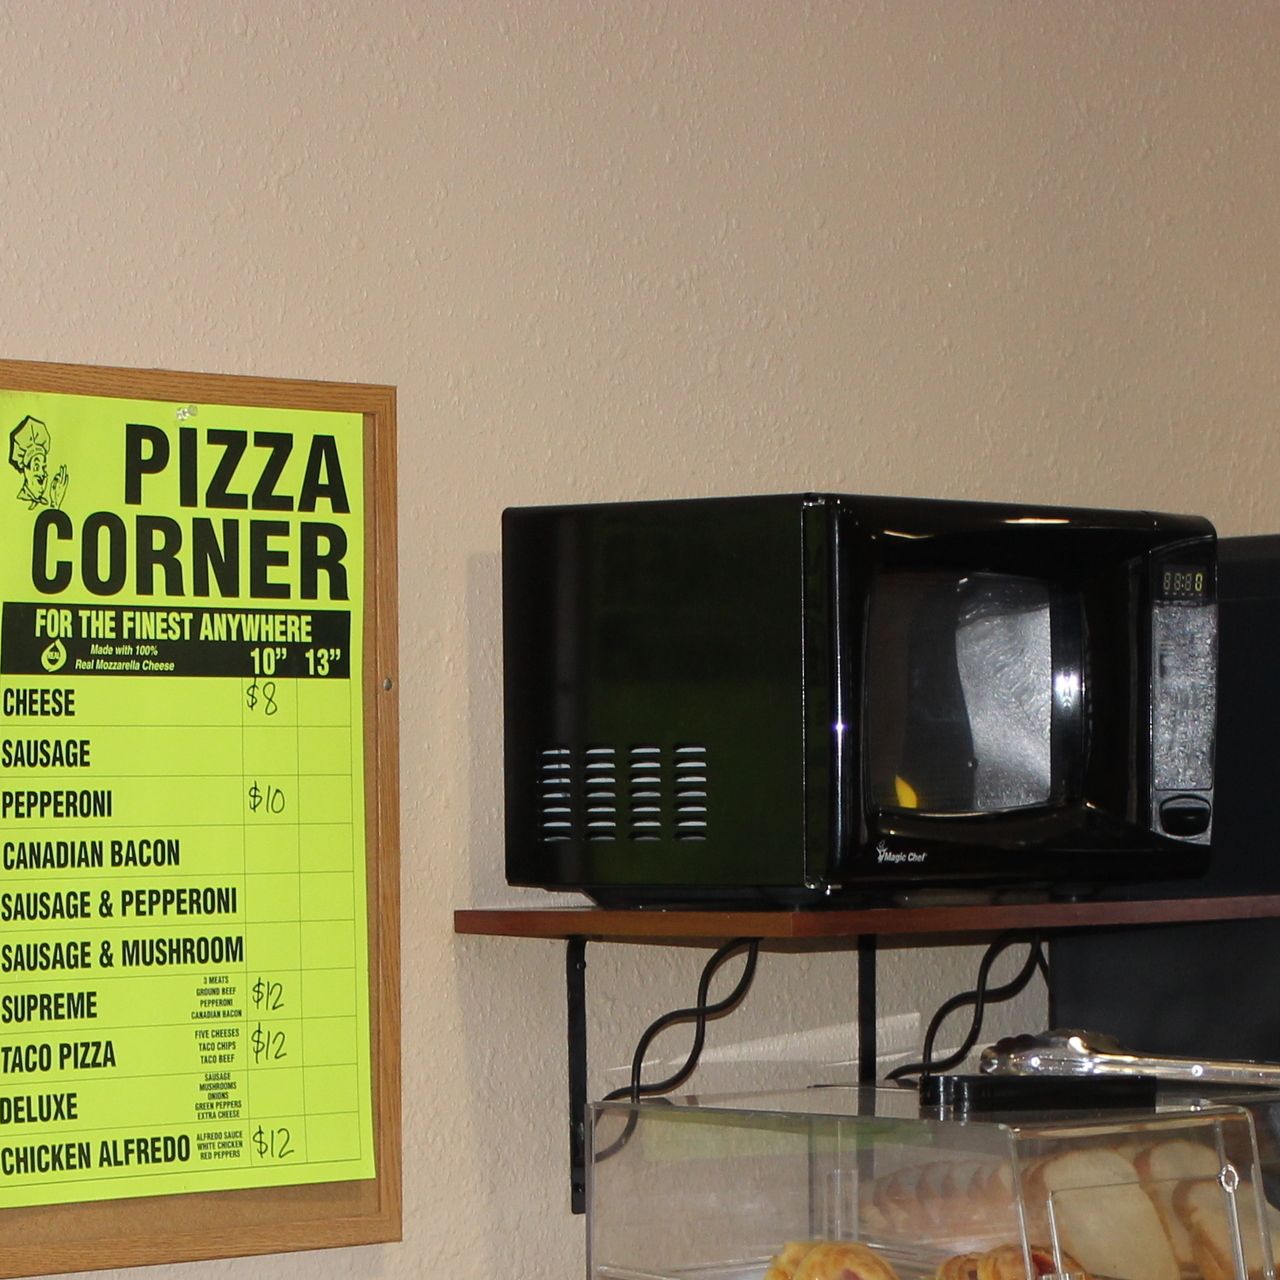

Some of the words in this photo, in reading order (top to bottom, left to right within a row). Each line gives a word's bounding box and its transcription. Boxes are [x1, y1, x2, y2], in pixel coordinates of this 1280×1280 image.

[124, 424, 351, 514] PIZZA
[32, 509, 350, 601] CORNER
[35, 609, 73, 639] FOR
[79, 611, 116, 640] THE
[122, 611, 193, 642] FINEST
[200, 613, 313, 644] ANYWHERE
[91, 644, 114, 655] Made
[115, 644, 133, 656] with
[135, 645, 159, 657] 100%
[75, 658, 94, 670] Real
[95, 659, 140, 671] Mozzarella
[141, 660, 175, 672] Cheese
[3, 688, 75, 717] CHEESE
[246, 677, 279, 716] $8
[1, 739, 90, 768] SAUSAGE
[2, 790, 112, 819] PEPPERONI
[248, 781, 286, 814] $10
[3, 841, 104, 870] CANADIAN
[111, 839, 180, 867] BACON
[883, 851, 907, 864] Magic
[907, 851, 926, 863] Chef
[1, 890, 91, 921] SAUSAGE
[98, 891, 113, 917] &
[121, 887, 238, 917] PEPPERONI
[1, 941, 91, 972] SAUSAGE
[99, 940, 114, 967] &
[121, 936, 244, 968] MUSHROOM
[208, 975, 229, 985] MEATS
[196, 987, 220, 996] GROUND
[221, 986, 237, 996] BEEF
[252, 976, 285, 1011] $12
[1, 991, 98, 1024] SUPREME
[200, 998, 233, 1008] PEPPERONI
[191, 1010, 221, 1020] CANADIAN
[222, 1009, 242, 1019] BACON
[195, 1029, 209, 1039] FIVE
[211, 1028, 240, 1038] CHEESES
[251, 1021, 288, 1064] $12
[1, 1043, 52, 1074] TACO
[59, 1040, 116, 1071] PIZZA
[199, 1042, 215, 1052] TACO
[217, 1041, 236, 1051] CHIPS
[200, 1055, 217, 1064] TACO
[218, 1054, 235, 1064] BEEF
[199, 1081, 237, 1091] MUSHROOMS
[204, 1072, 231, 1082] SAUSAGE
[195, 1101, 214, 1111] GREEN
[215, 1100, 242, 1110] PEPPERS
[207, 1091, 229, 1101] ONIONS
[0, 1092, 78, 1125] DELUXE
[197, 1111, 216, 1120] EXTRA
[218, 1110, 240, 1119] CHEESE
[196, 1132, 222, 1141] ALFREDO
[224, 1130, 243, 1139] SAUCE
[197, 1142, 216, 1151] WHITE
[217, 1140, 243, 1149] CHICKEN
[252, 1124, 295, 1159] $12
[1, 1142, 92, 1176] CHICKEN
[99, 1134, 191, 1168] ALFREDO
[200, 1151, 212, 1160] RED
[214, 1150, 240, 1159] PEPPERS
